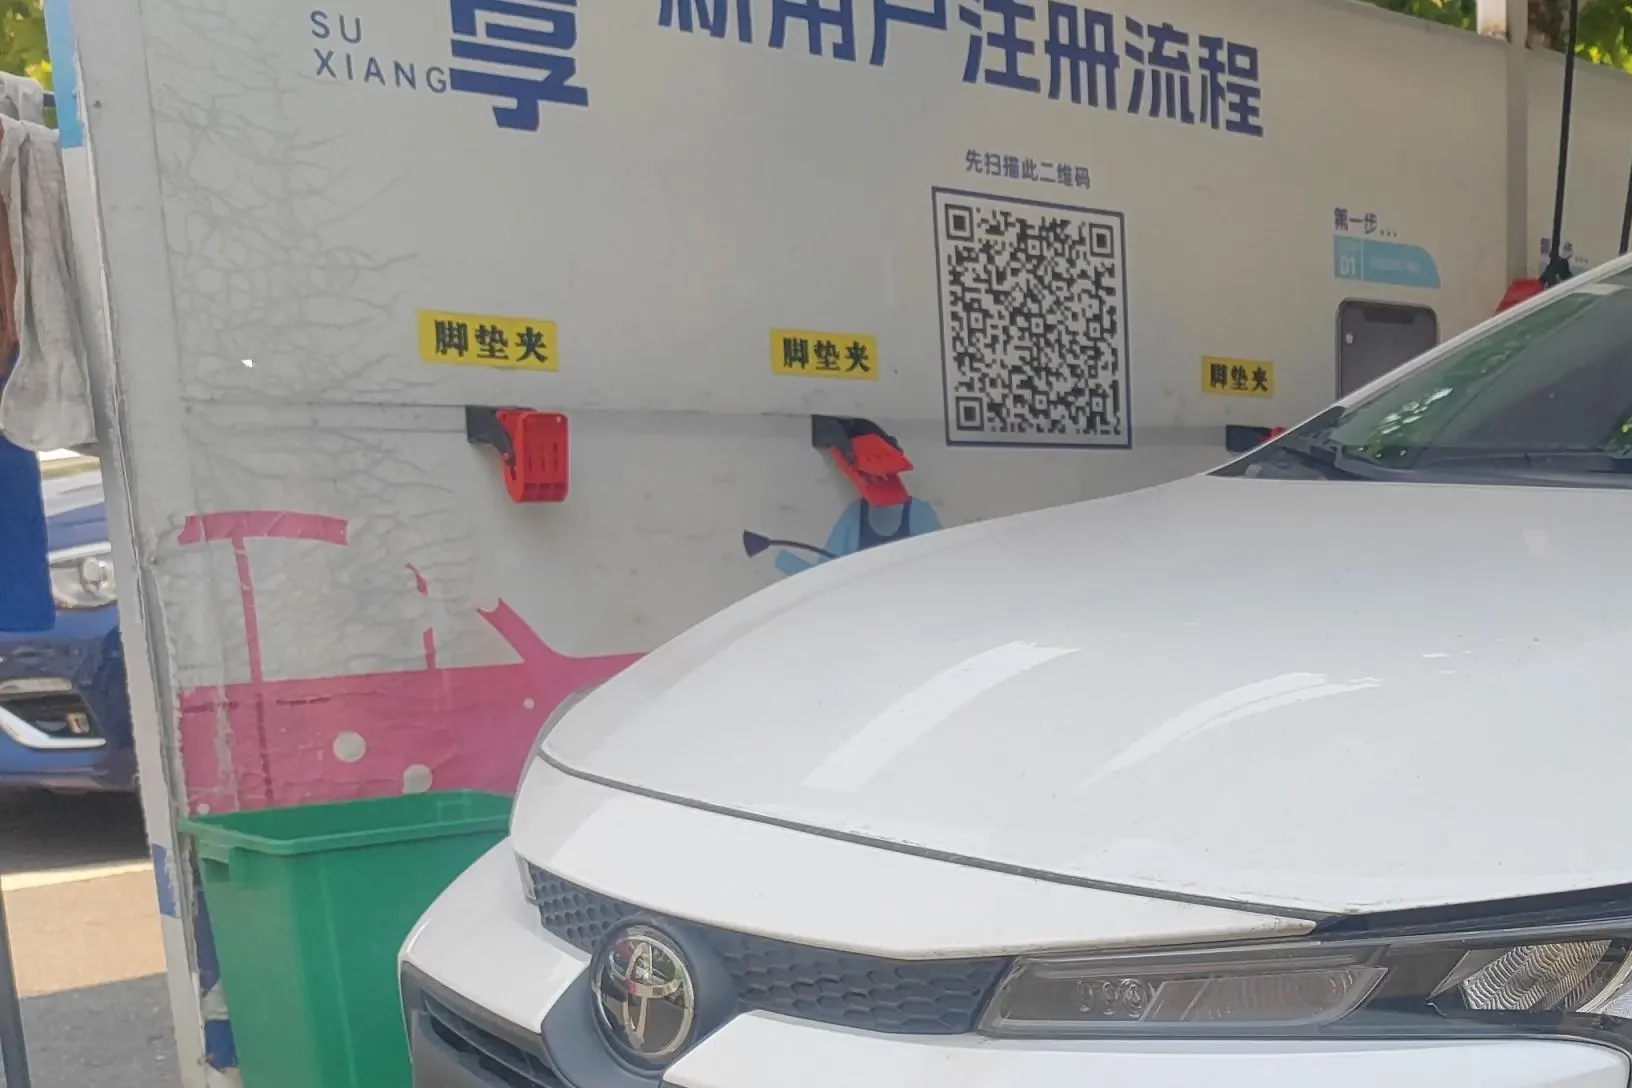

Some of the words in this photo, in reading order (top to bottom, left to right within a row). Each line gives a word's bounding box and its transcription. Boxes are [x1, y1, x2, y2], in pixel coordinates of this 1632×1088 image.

[311, 10, 361, 44] SU
[313, 48, 447, 93] XIANG
[449, 0, 589, 132] 享
[965, 148, 1091, 190] 先扫描此二维码
[434, 319, 548, 363] 脚垫夹
[783, 337, 871, 372] 脚垫夹
[1210, 363, 1269, 392] 脚垫夹
